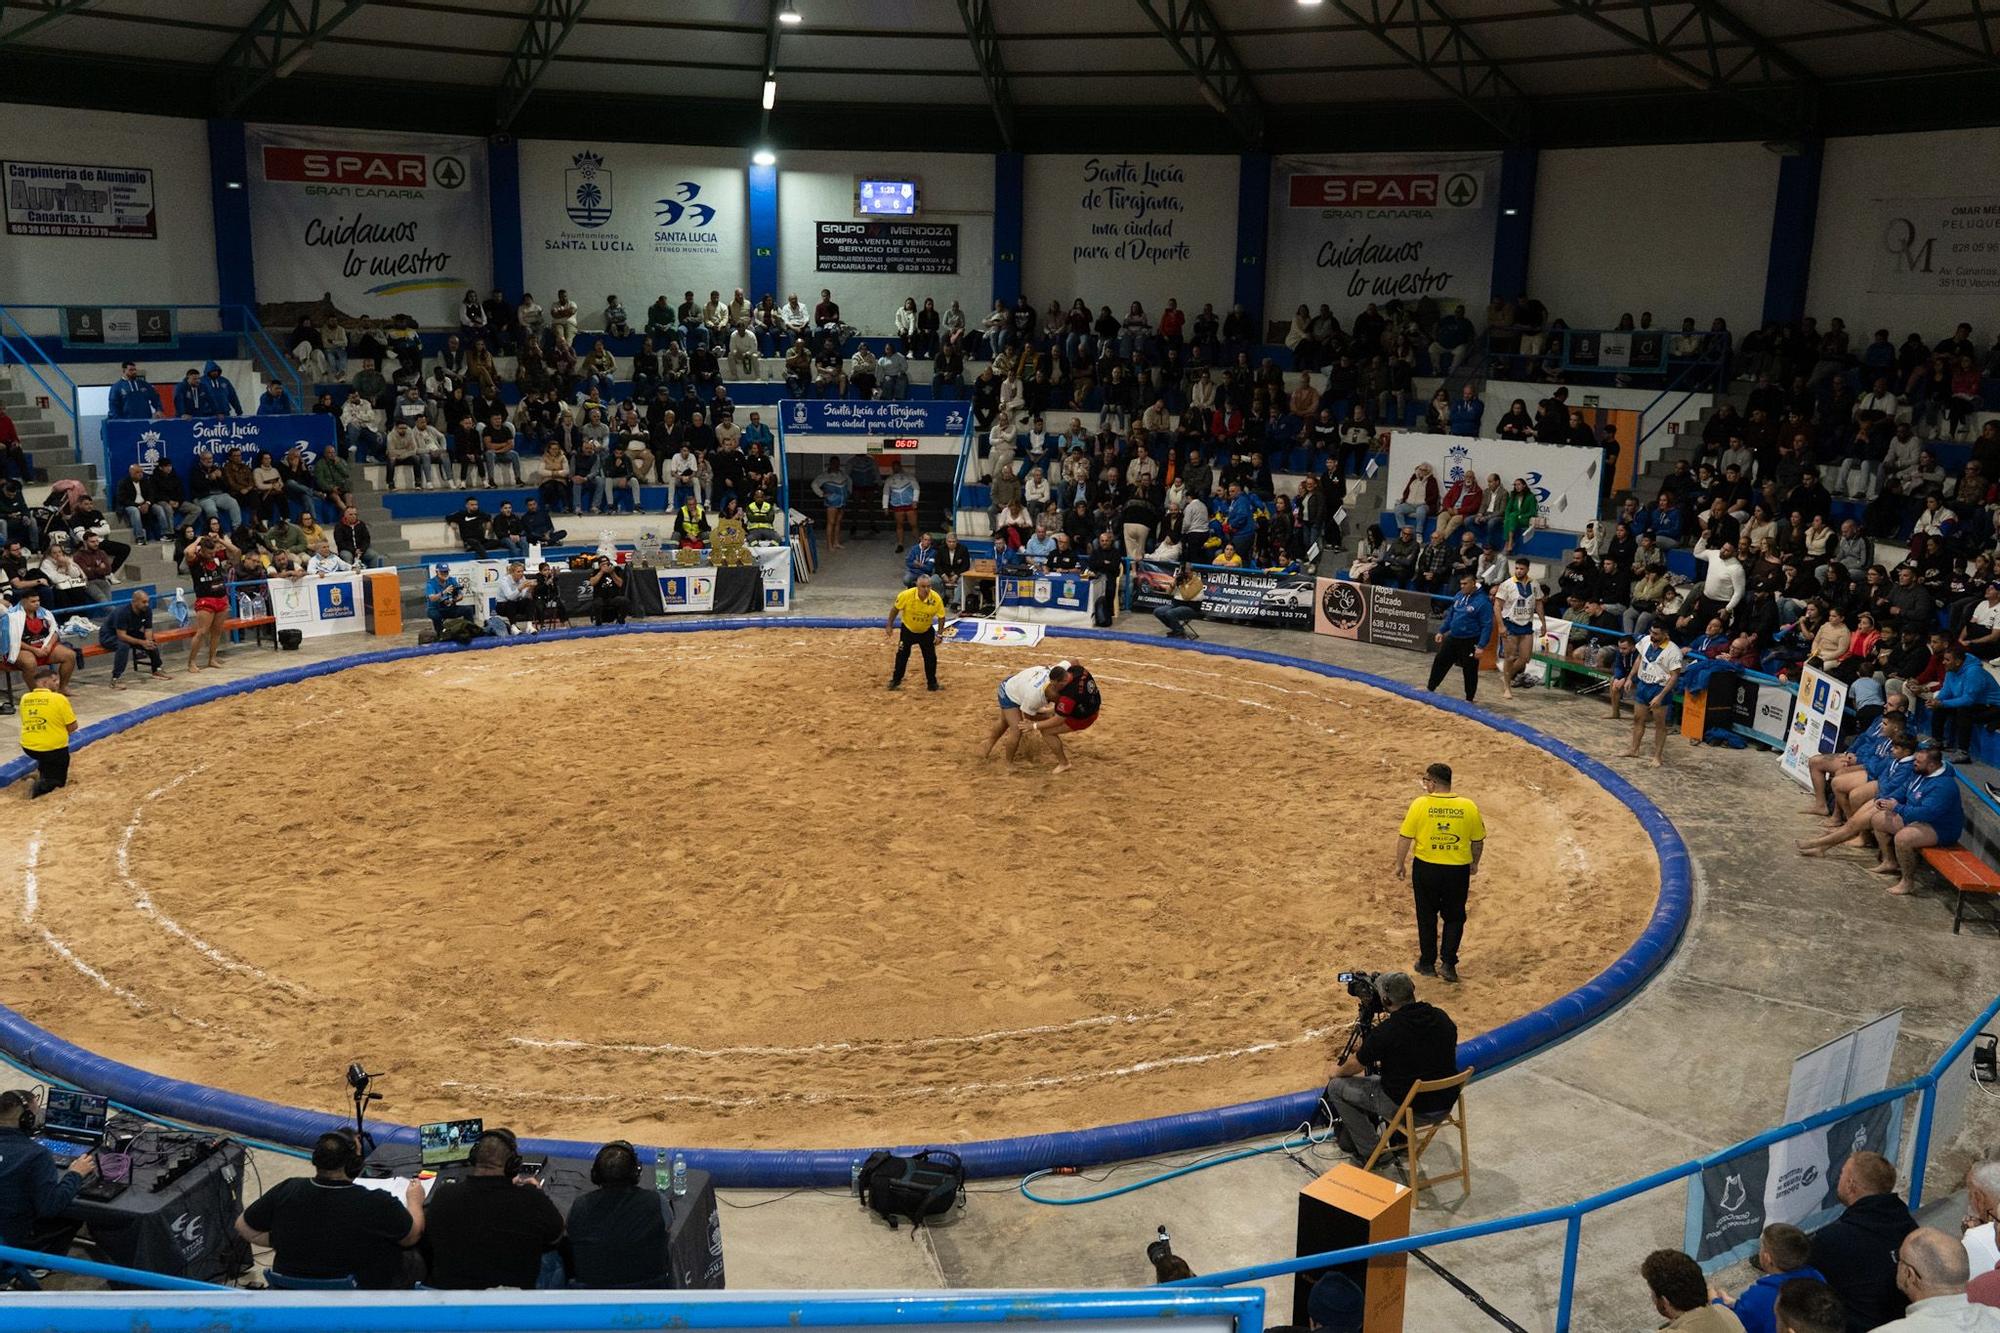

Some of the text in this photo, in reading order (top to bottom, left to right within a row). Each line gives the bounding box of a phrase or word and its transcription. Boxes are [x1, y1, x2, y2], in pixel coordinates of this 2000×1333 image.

[304, 154, 424, 183] SPAR
[1084, 158, 1184, 188] Santa Lucía
[80, 169, 95, 183] de
[97, 170, 147, 185] Aluminio
[305, 185, 424, 200] GRAN CANARIA
[1323, 179, 1436, 202] SPAR
[1082, 186, 1184, 219] de Tirajana,
[1321, 209, 1433, 219] GRAN CANARIA
[1952, 207, 1981, 215] OMAR
[304, 213, 418, 247] Cuidamos
[821, 224, 953, 236] GRUPO MENDOZA
[1092, 219, 1173, 237] una ciudad
[560, 231, 619, 240] Ayuntamiento
[654, 231, 718, 243] SANTA LUCIA
[823, 237, 859, 245] COMPRA
[865, 238, 890, 246] VENTA
[544, 239, 634, 251] SANTA LUCIA
[838, 245, 884, 253] SERVICIO
[886, 246, 900, 254] DE
[1073, 238, 1191, 265] para el Deporte
[1316, 234, 1422, 268] Cuidamos
[343, 247, 452, 278] lo nuestro
[831, 262, 867, 271] CANARIAS
[876, 263, 887, 271] 412
[937, 264, 952, 272] 774
[1346, 267, 1454, 298] lo nuestro
[823, 403, 929, 419] Santa Lucía de Tirajana,
[193, 422, 260, 440] Santa Lucía
[841, 419, 866, 429] ciudad
[868, 421, 886, 431] para
[887, 419, 895, 429] el
[895, 419, 924, 431] Deporte
[193, 441, 207, 456] de
[1207, 573, 1229, 585] VENTA
[1229, 574, 1239, 585] DE
[1222, 587, 1263, 599] MENDOZA
[1375, 585, 1393, 596] Ropa
[1374, 595, 1402, 607] Calzado
[1214, 602, 1229, 613] EN
[1229, 604, 1260, 616] VENTA
[1374, 604, 1426, 620] Complementos
[1372, 619, 1410, 632] 638 473 293
